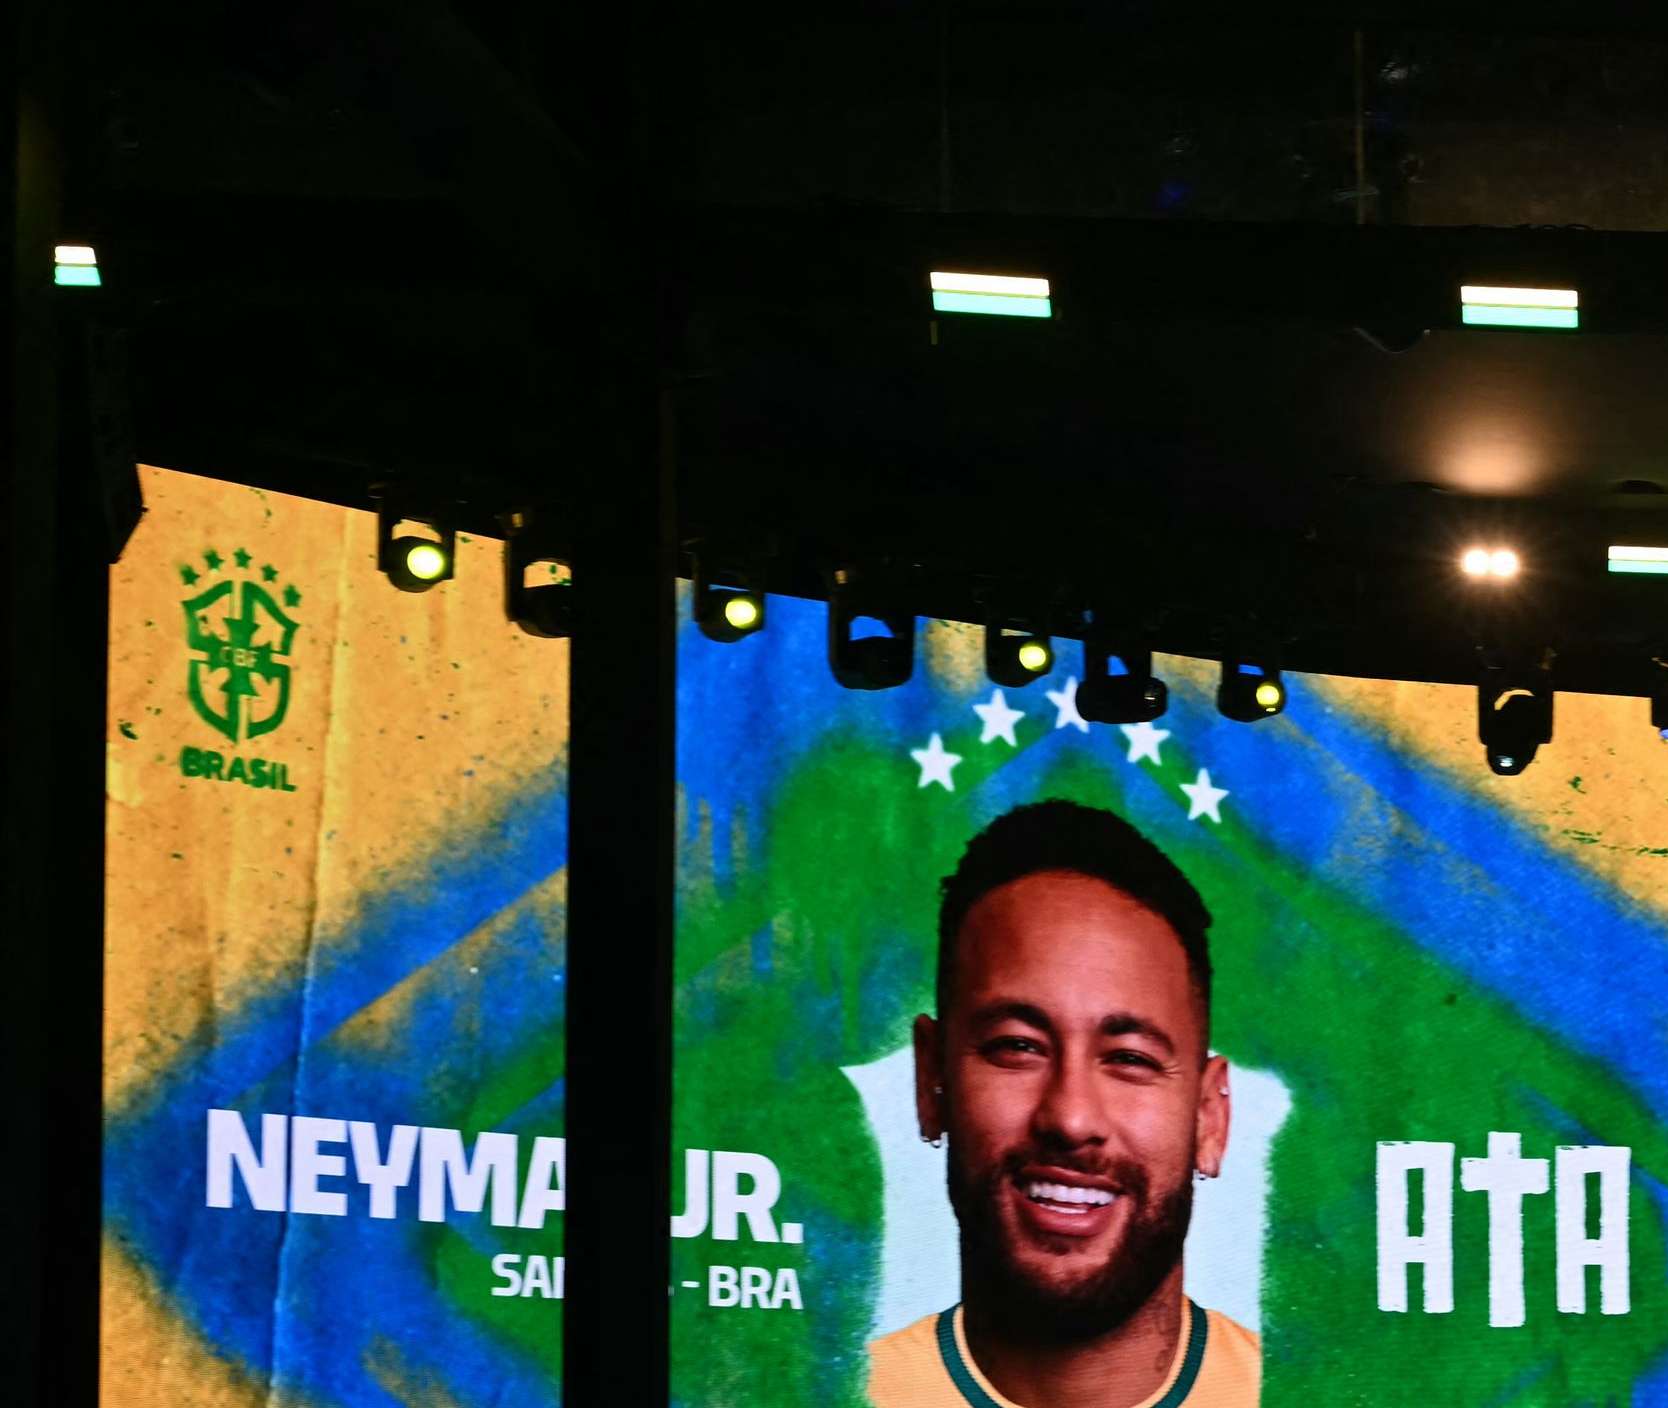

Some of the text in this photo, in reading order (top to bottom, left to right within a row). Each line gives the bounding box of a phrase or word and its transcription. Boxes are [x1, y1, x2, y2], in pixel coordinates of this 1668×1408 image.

[180, 745, 297, 793] BRASIL
[207, 1108, 803, 1244] NEYMA JR.
[1376, 1131, 1631, 1328] ATA
[708, 1265, 804, 1310] BRA
